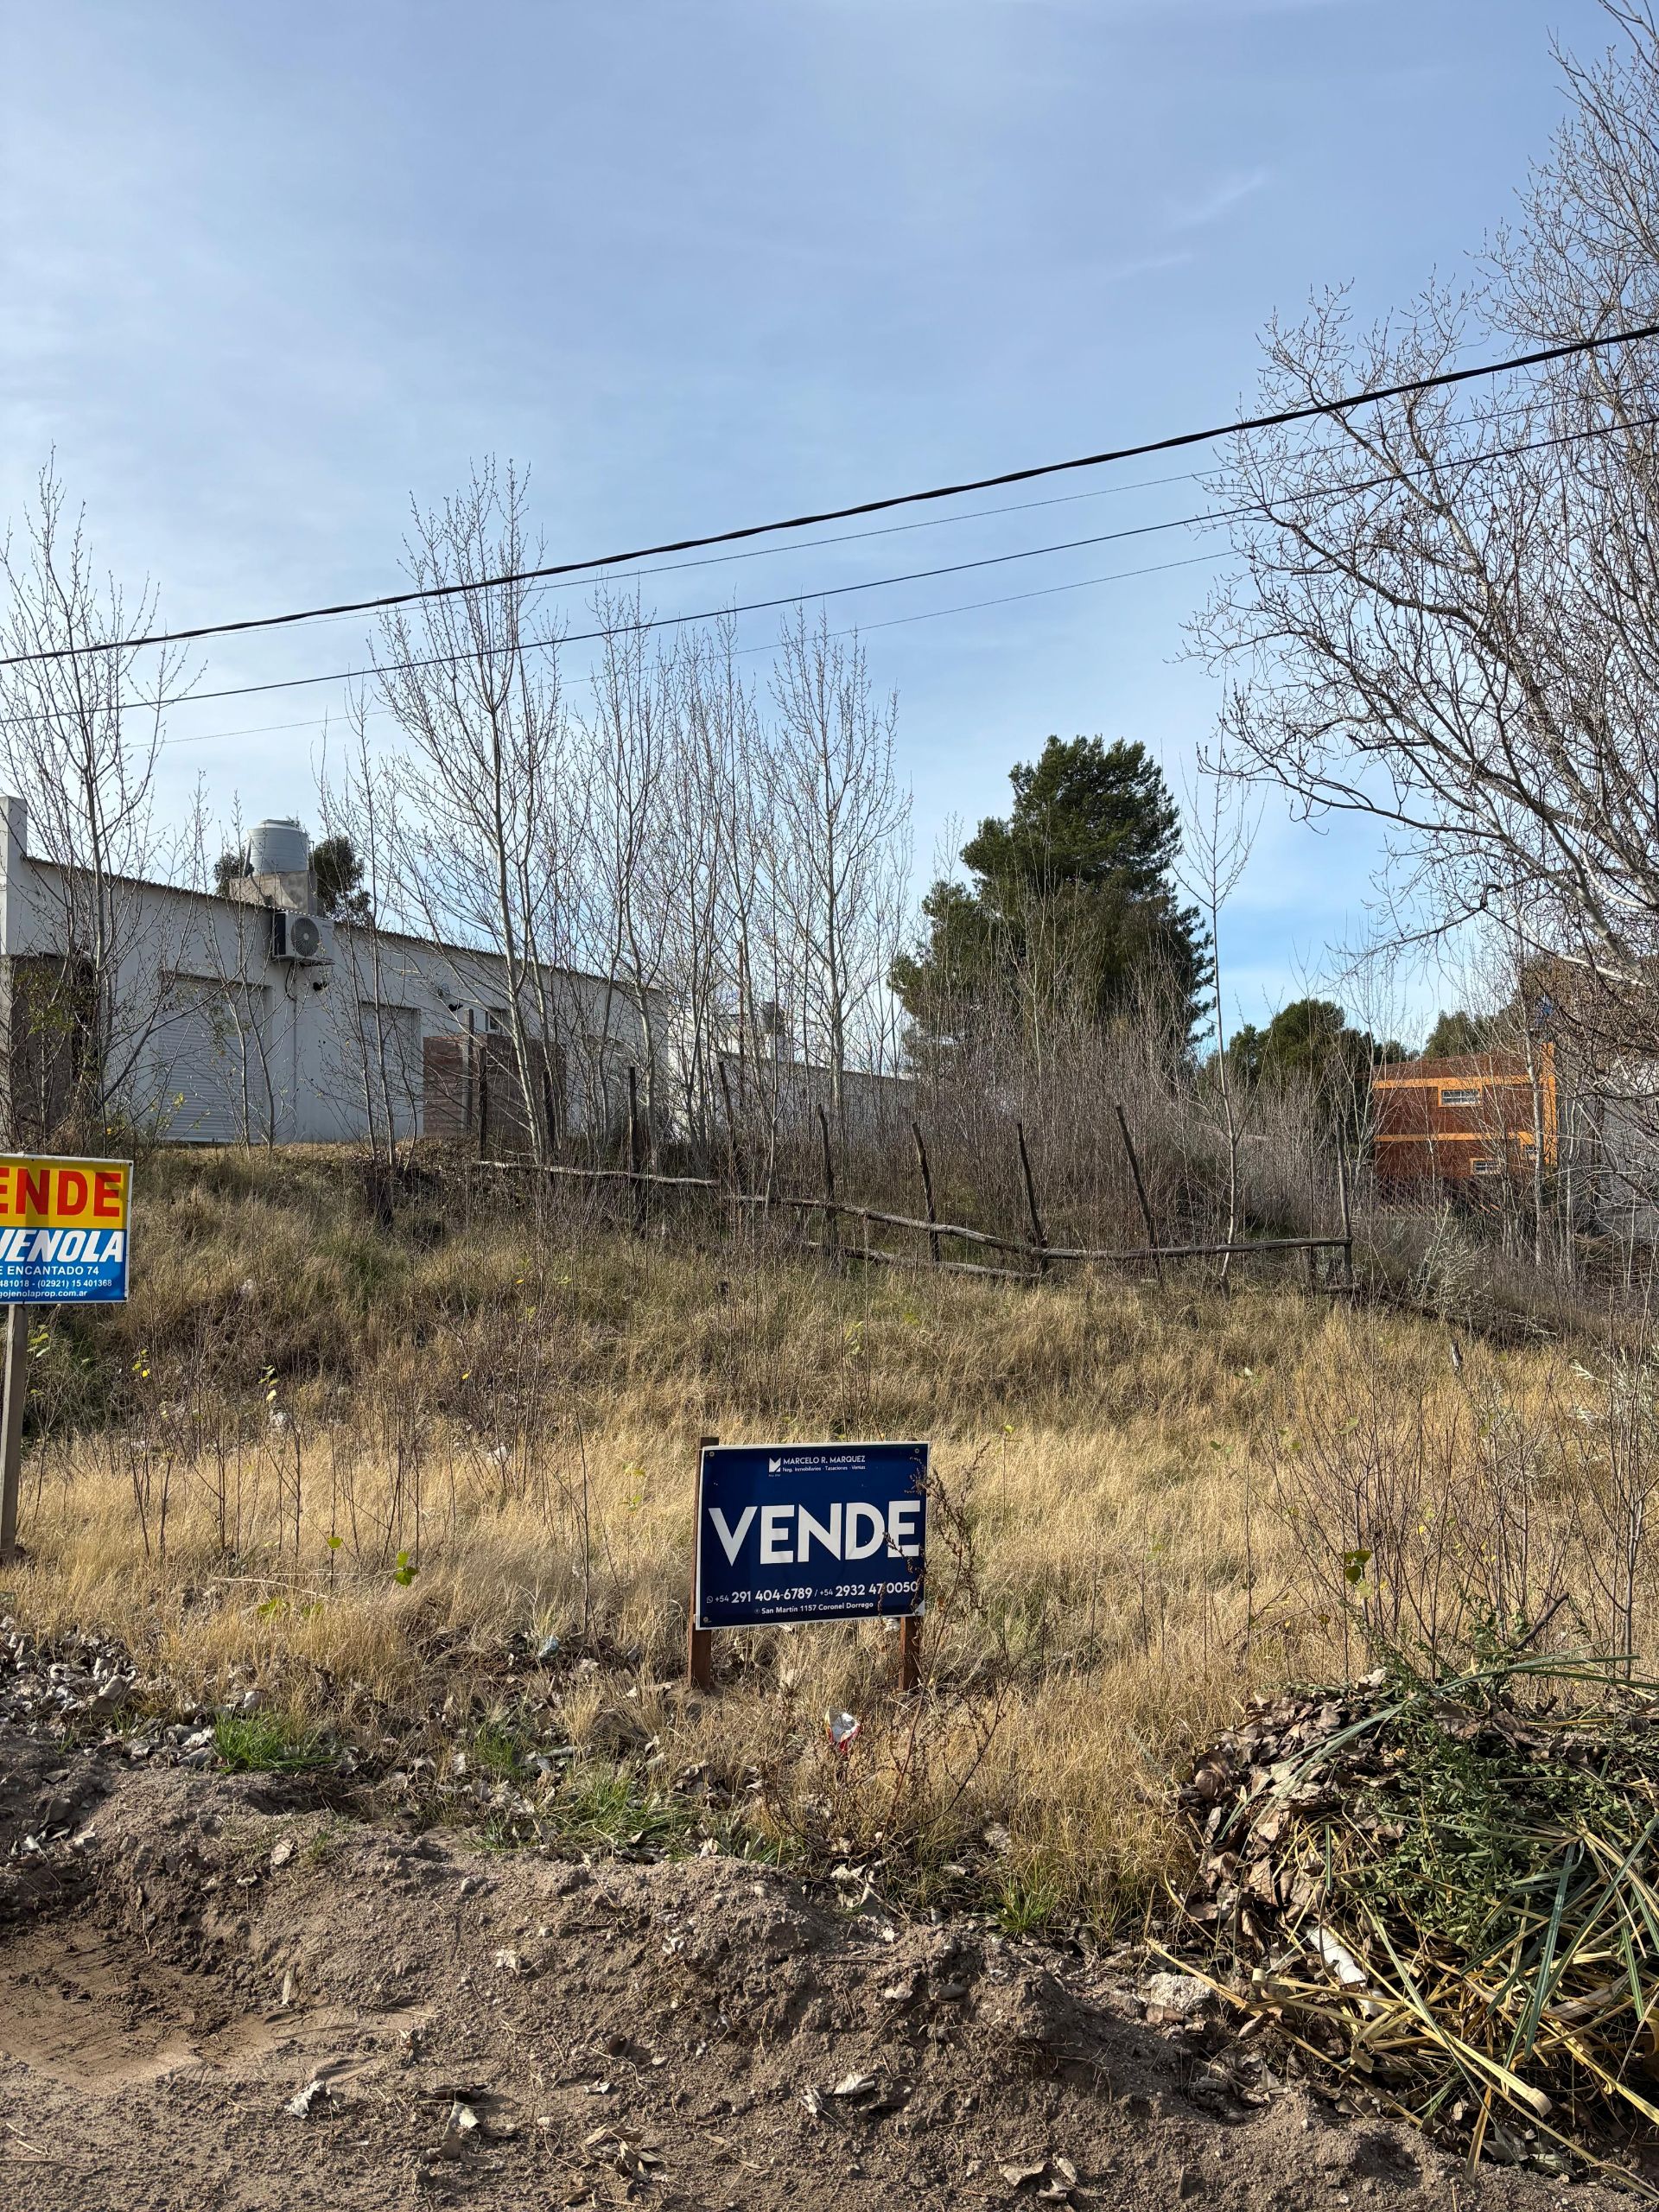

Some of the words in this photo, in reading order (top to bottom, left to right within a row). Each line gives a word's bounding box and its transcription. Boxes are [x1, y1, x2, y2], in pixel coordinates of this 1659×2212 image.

[7, 1266, 84, 1275] ENCANTADO
[87, 1266, 99, 1275] 74
[37, 1279, 69, 1289] (02921)
[72, 1279, 81, 1287] 15
[83, 1279, 112, 1287] 401368
[830, 1455, 866, 1464] MARQUEZ
[708, 1500, 921, 1567] VENDE
[731, 1591, 752, 1604] 291
[754, 1587, 813, 1602] 404-6789
[819, 1588, 834, 1597] +54
[835, 1584, 866, 1598] 2932
[799, 1604, 817, 1612] 1157
[817, 1602, 845, 1611] Coronel
[846, 1601, 874, 1611] Dorrego
